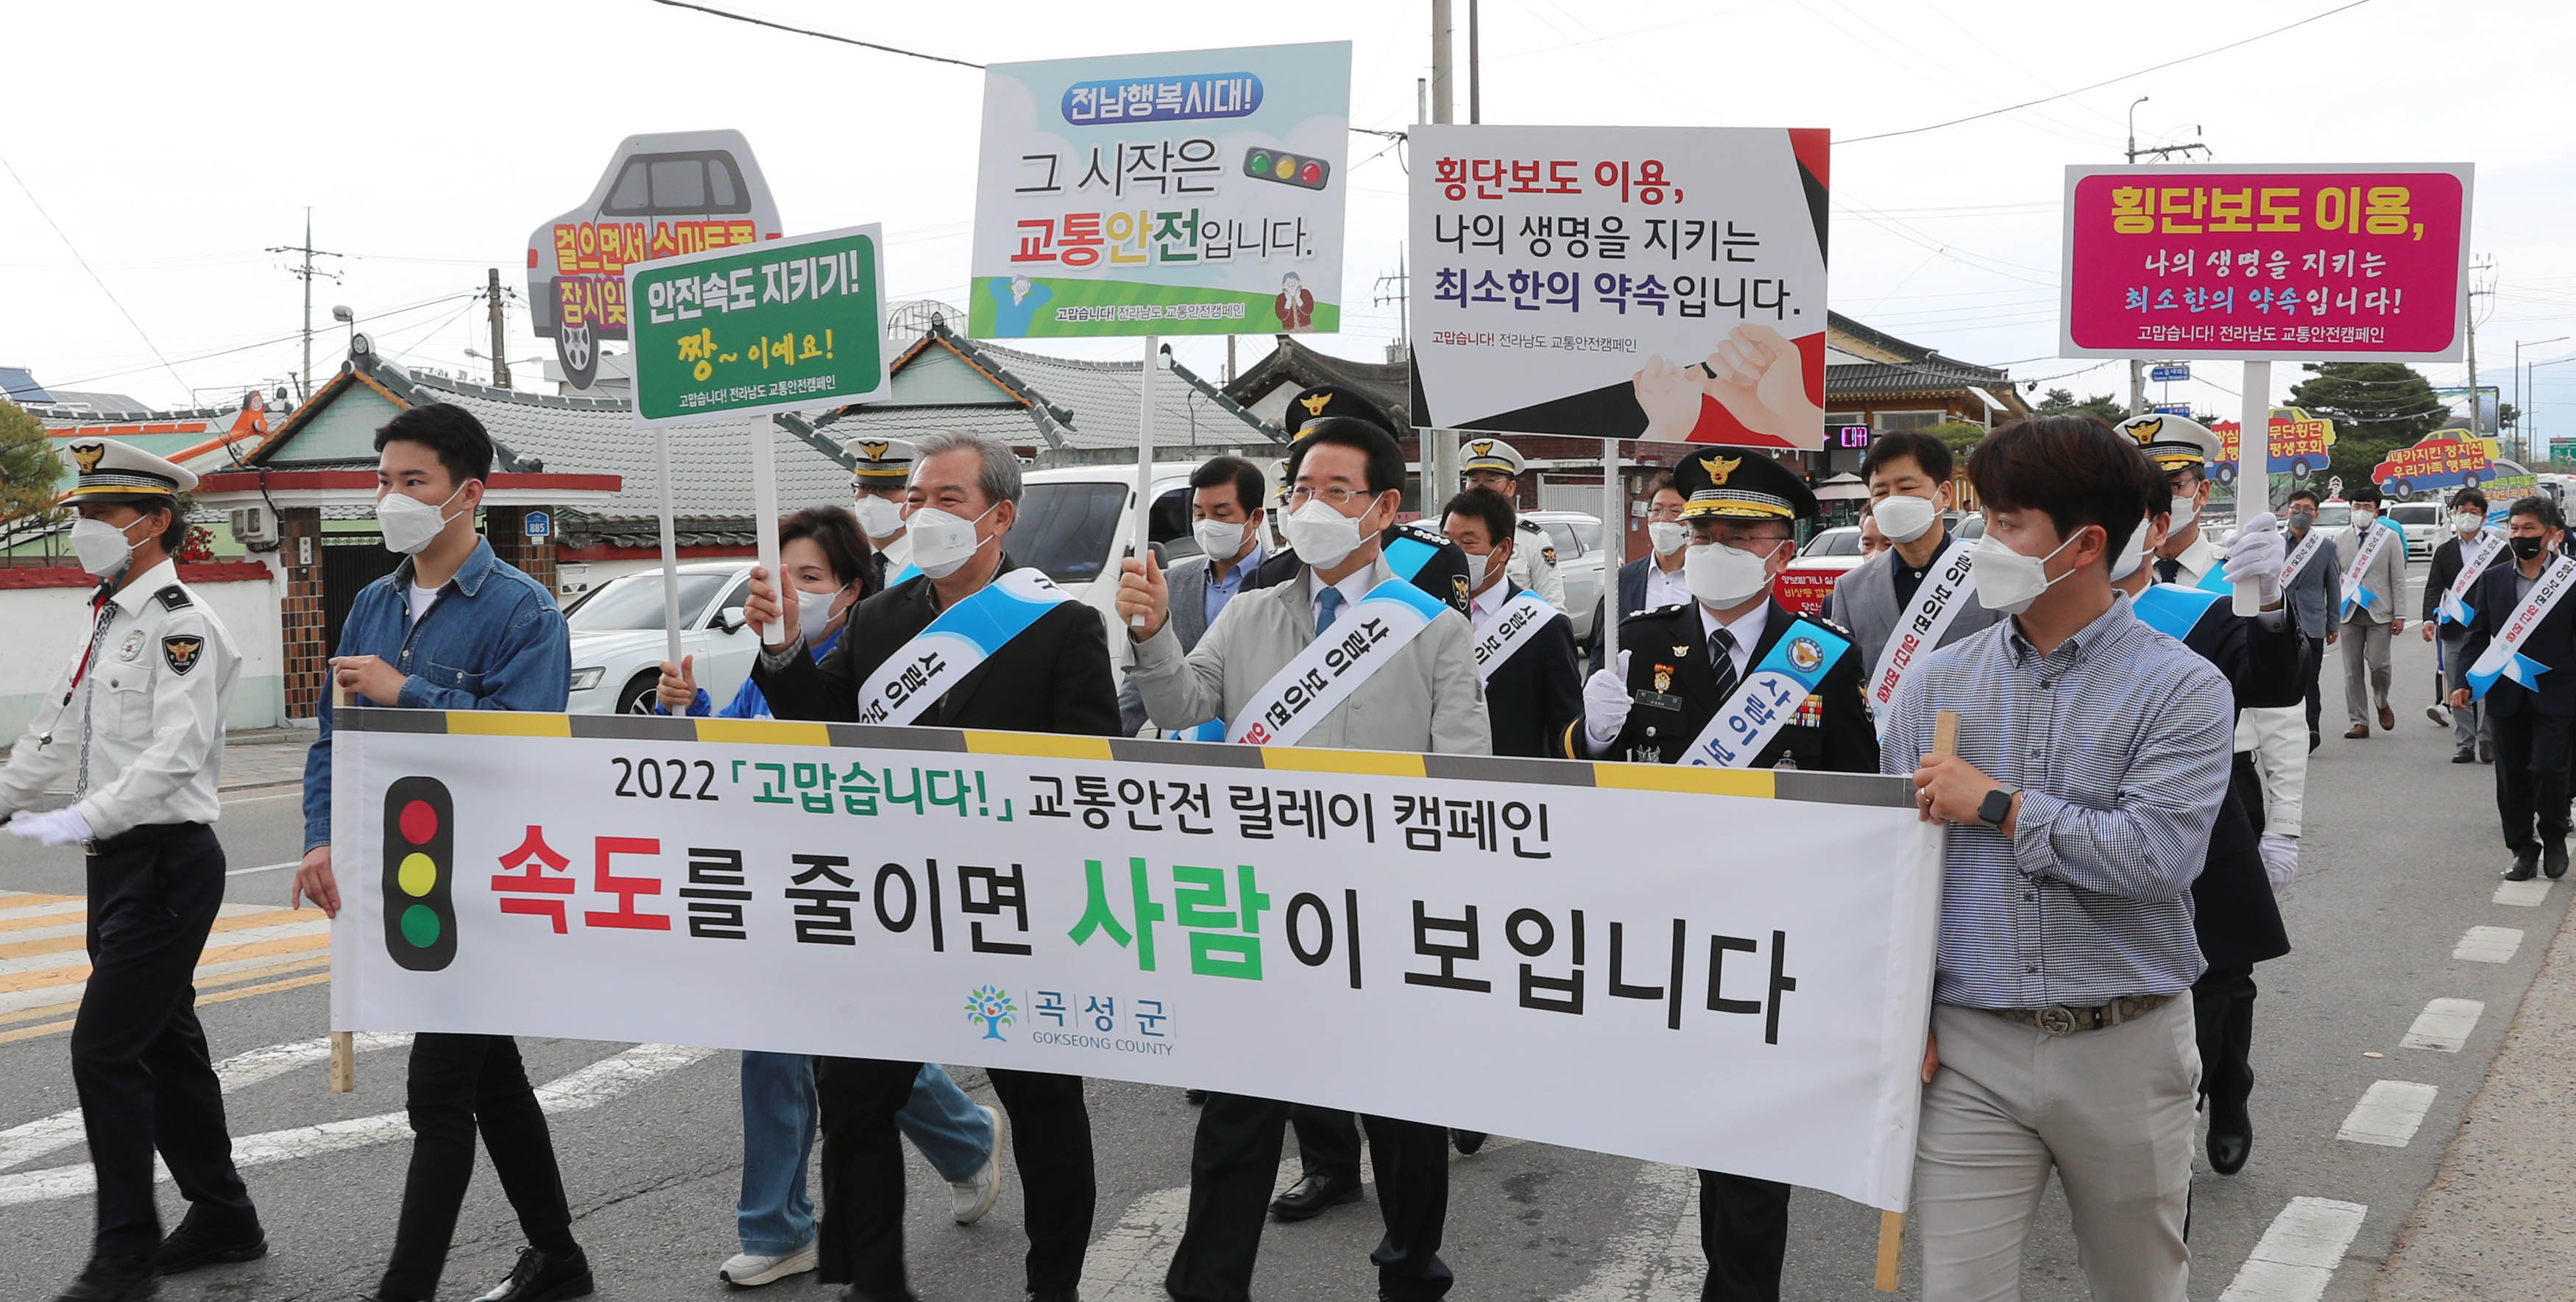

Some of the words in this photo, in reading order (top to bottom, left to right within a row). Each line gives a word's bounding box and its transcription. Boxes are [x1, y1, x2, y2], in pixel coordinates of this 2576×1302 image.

[1071, 78, 1252, 121] 전남행복시대!
[1015, 155, 1061, 192] 그
[1078, 139, 1220, 196] 시작은
[1434, 157, 1582, 201] 횡단보도
[1594, 160, 1684, 205] 이용,
[2112, 186, 2301, 234] 횡단보도
[2315, 186, 2424, 241] 이용,
[556, 227, 645, 271] 걸으면서
[1011, 208, 1312, 265] 교통안전입니다.
[1435, 214, 1504, 255] 나의
[1519, 215, 1630, 260] 생명을
[1644, 219, 1760, 262] 지키는
[2145, 250, 2195, 277] 나의
[2206, 250, 2290, 279] 생명을
[2302, 250, 2388, 278] 지키는
[648, 266, 756, 325] 안전속도
[762, 250, 859, 305] 지키기!
[1434, 267, 1579, 313] 최소한의
[1594, 273, 1801, 320] 약속입니다.
[2126, 287, 2234, 314] 최소한의
[2248, 287, 2402, 316] 약속입니다!
[1057, 306, 1114, 321] 고맙습니다!
[1119, 305, 1162, 320] 전라남도
[1165, 304, 1245, 319] 교통안전캠페인
[1432, 331, 1495, 347] 고맙습니다!
[1498, 333, 1546, 348] 전라남도
[1551, 336, 1638, 353] 교통안전캠페인
[2137, 326, 2214, 342] 고맙습니다!
[2219, 326, 2277, 342] 전라남도
[2281, 327, 2385, 344] 교통안전캠페인
[679, 389, 727, 408] 고맙습니다!
[729, 383, 765, 402] 전라남도
[769, 375, 836, 396] 교통안전캠페인
[2269, 422, 2323, 439] 무단횡단
[2269, 440, 2322, 457] 평생후회
[2391, 447, 2442, 464] 내가지킨
[2445, 442, 2483, 457] 정지선
[2393, 461, 2444, 478] 우리가족
[2446, 457, 2485, 473] 행복선
[530, 523, 545, 532] 885
[1945, 550, 1972, 587] 람이
[1784, 588, 1812, 598] 비상등
[1913, 584, 1953, 636] 보이면
[1498, 605, 1538, 642] 사람이
[1326, 618, 1390, 678] 사람이
[1475, 634, 1501, 665] 보이
[1893, 634, 1920, 670] 일단
[885, 652, 946, 710] 사람이
[1877, 668, 1900, 704] 멈춤
[1264, 668, 1328, 732] 보이면
[1729, 679, 1791, 746] 사람이
[1238, 722, 1271, 744] 일
[612, 757, 720, 801] 2022
[1029, 774, 1213, 836] 교통안전
[1228, 785, 1375, 843] 릴레이
[1394, 792, 1551, 860] 캠페인
[490, 825, 753, 941] 속도를
[784, 852, 1032, 955] 줄이면
[1068, 857, 1363, 990] 사람이
[1404, 899, 1797, 1046] 보입니다
[1033, 1032, 1111, 1050] GOKSEONG
[1116, 1039, 1172, 1055] COUNTY
